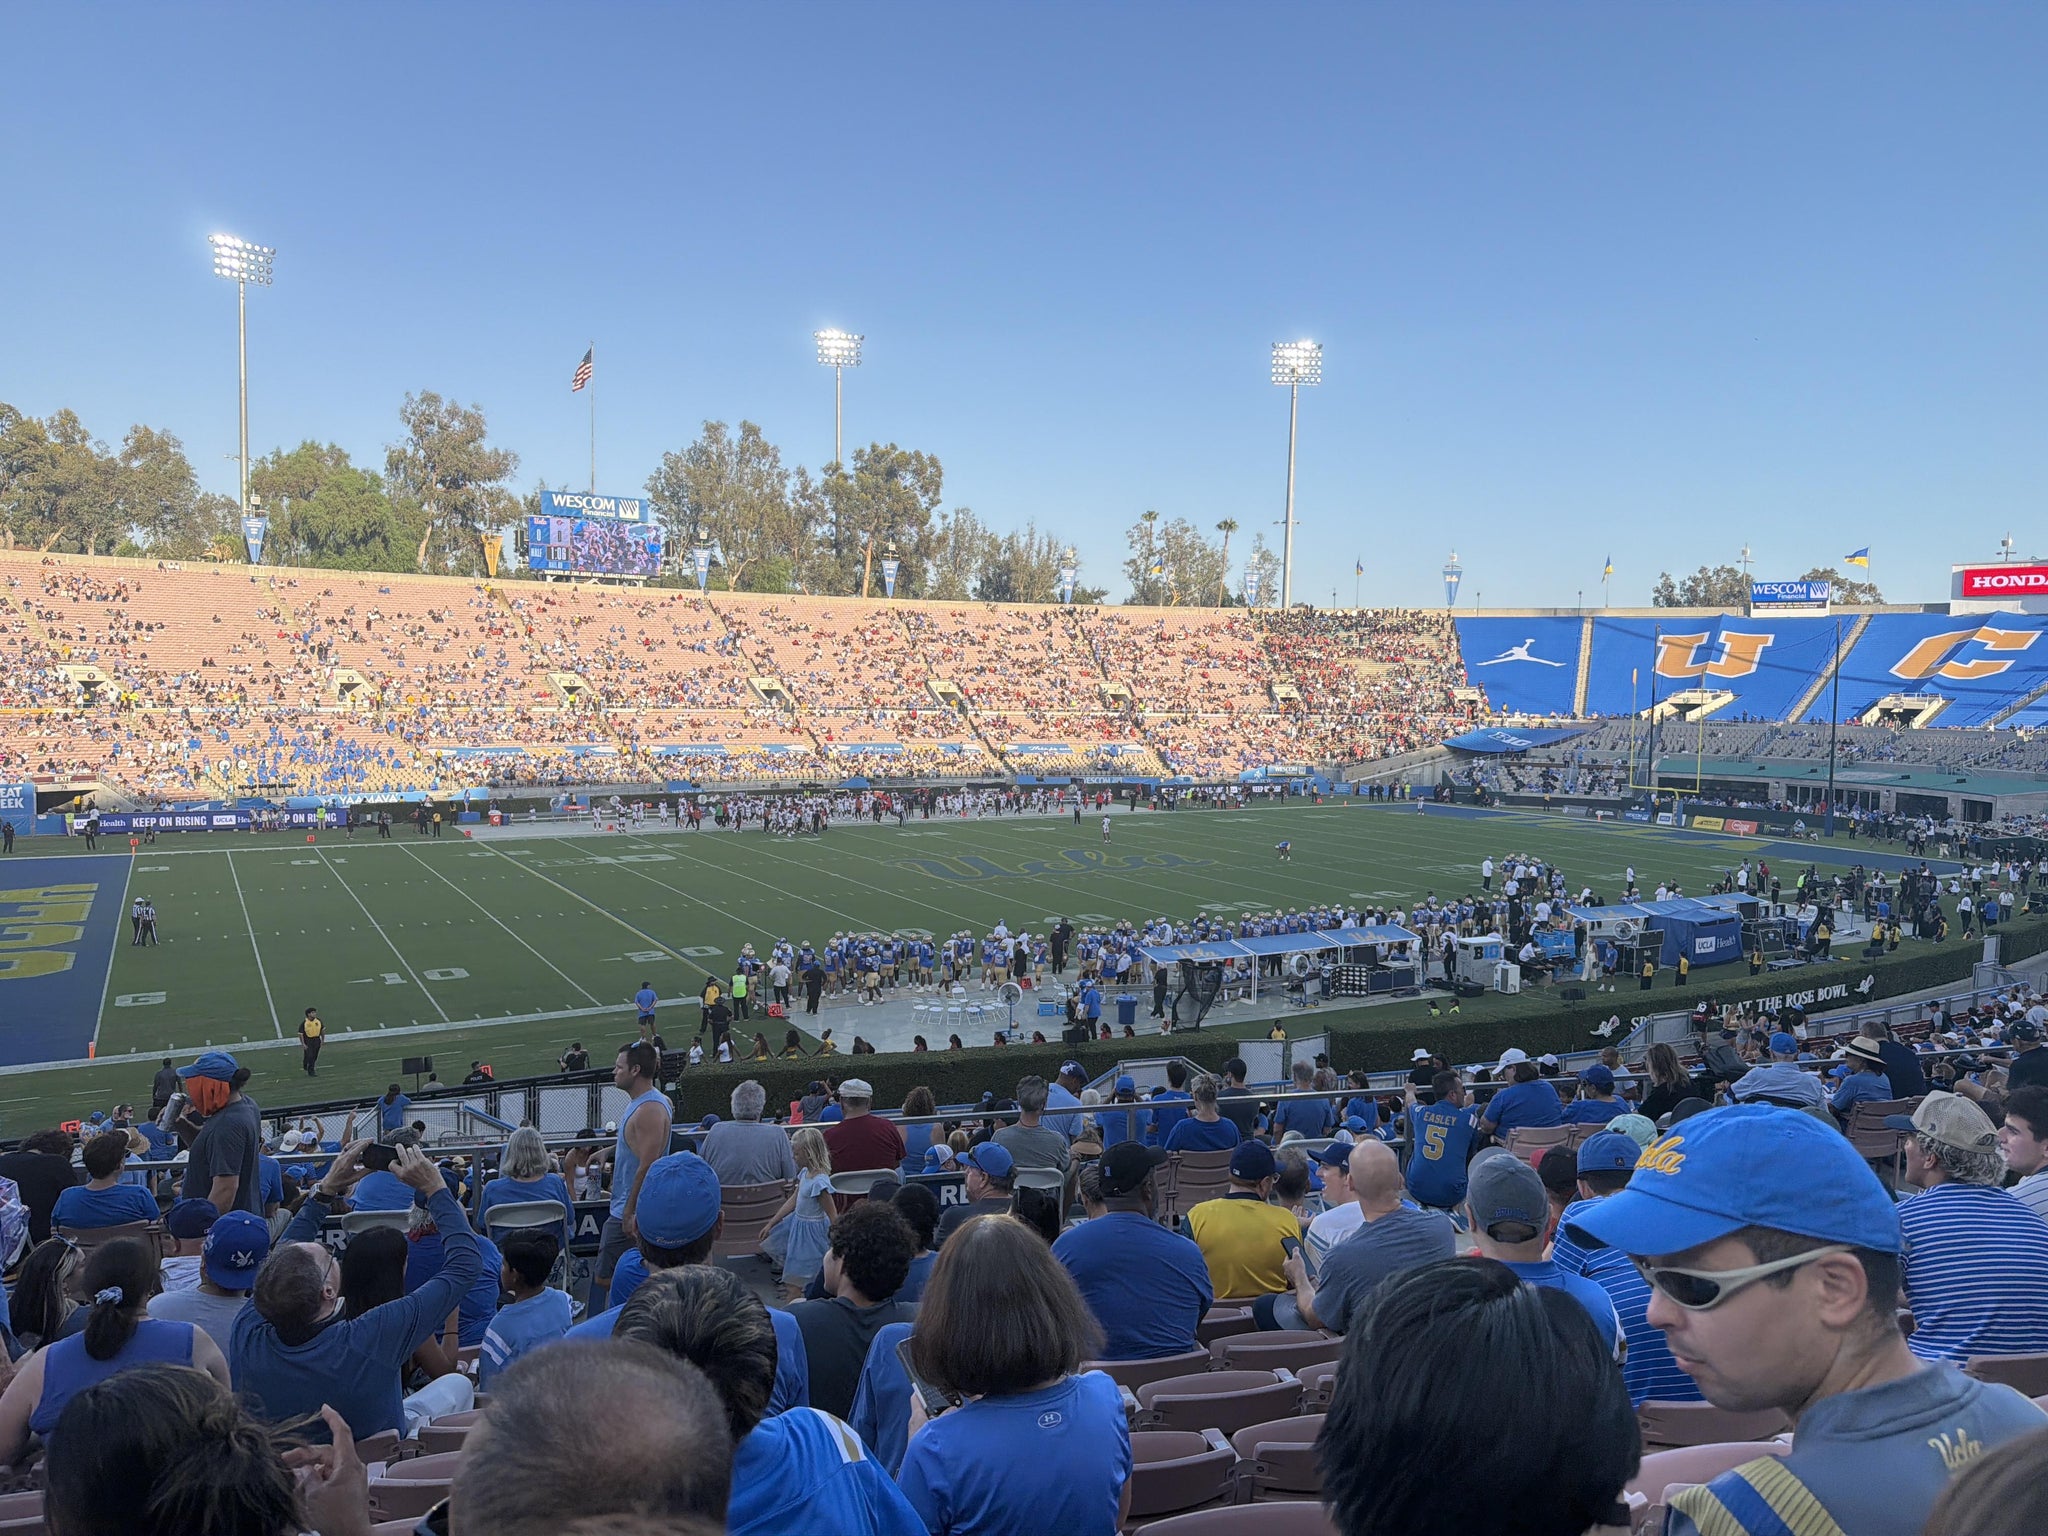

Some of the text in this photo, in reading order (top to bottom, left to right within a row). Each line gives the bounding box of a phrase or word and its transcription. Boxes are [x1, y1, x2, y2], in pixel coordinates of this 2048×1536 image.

[552, 494, 615, 510] WESCOM
[582, 509, 615, 517] Financial
[1972, 574, 2048, 588] HOND
[1752, 584, 1806, 594] WESCOM
[1652, 626, 2044, 680] U C
[100, 819, 126, 827] Health
[132, 815, 206, 828] KEEP ON RISING
[293, 814, 304, 823] ON
[1698, 935, 1736, 950] UCLA Health
[379, 967, 470, 985] 10
[1756, 996, 1783, 1012] THE
[1785, 990, 1815, 1008] ROSE
[1817, 984, 1848, 1001] BOWL
[1423, 1111, 1457, 1127] EASLEY
[1422, 1124, 1448, 1160] 5
